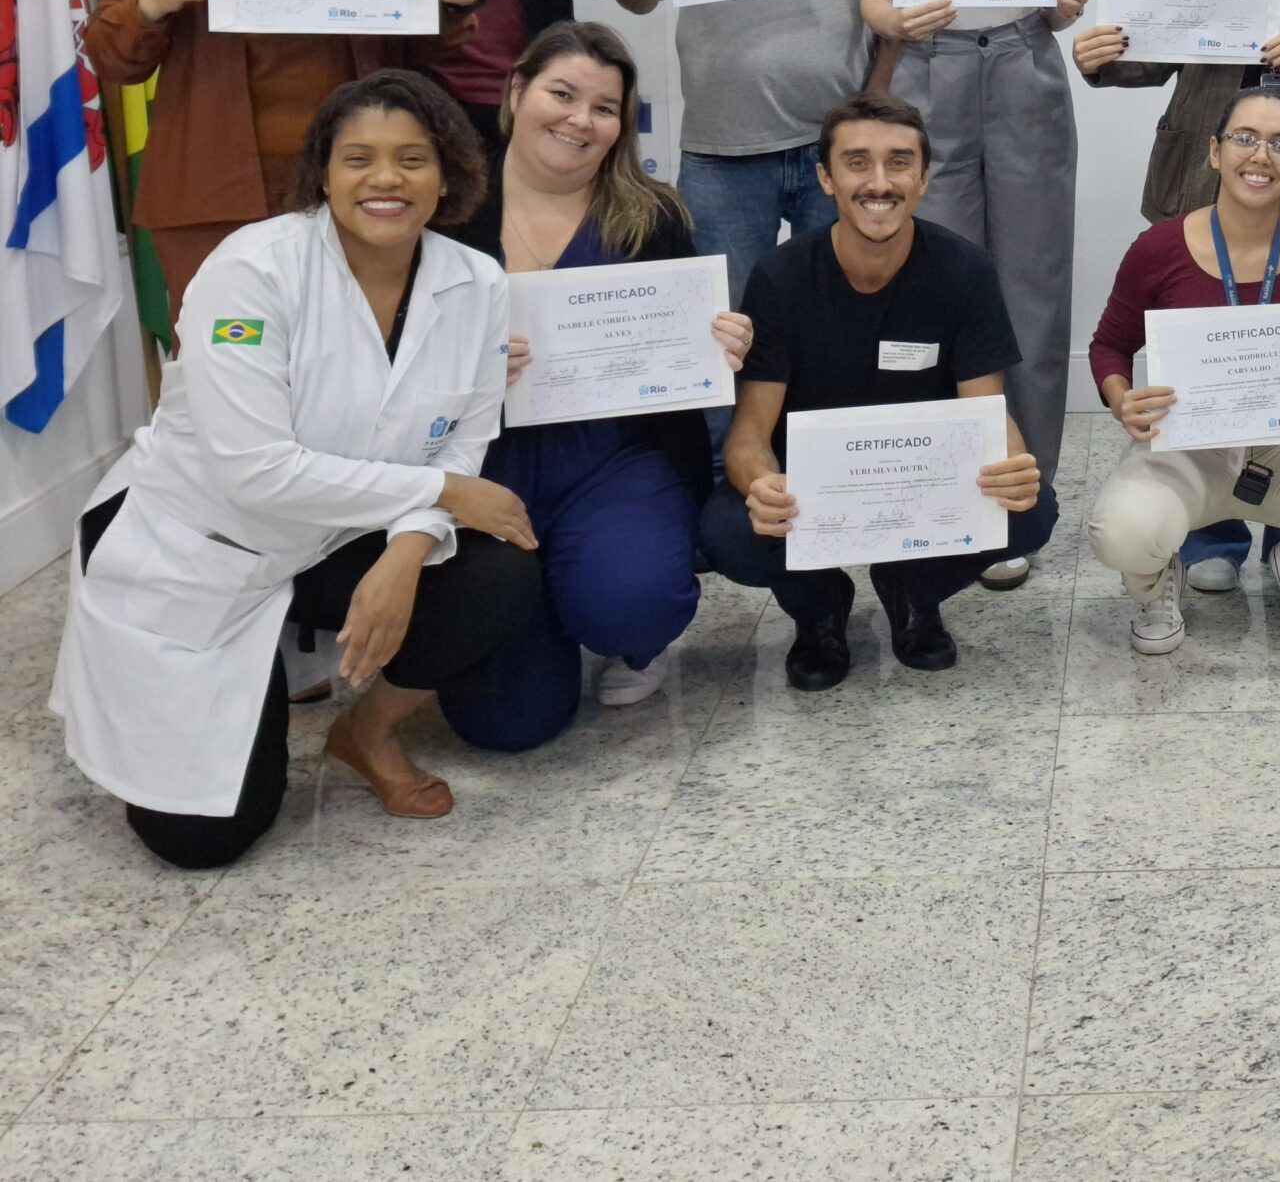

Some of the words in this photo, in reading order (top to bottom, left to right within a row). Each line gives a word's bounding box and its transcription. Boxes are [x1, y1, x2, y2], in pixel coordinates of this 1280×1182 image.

[568, 285, 657, 306] CERTIFICADO
[846, 436, 932, 452] CERTIFICADO
[849, 466, 871, 476] YURI
